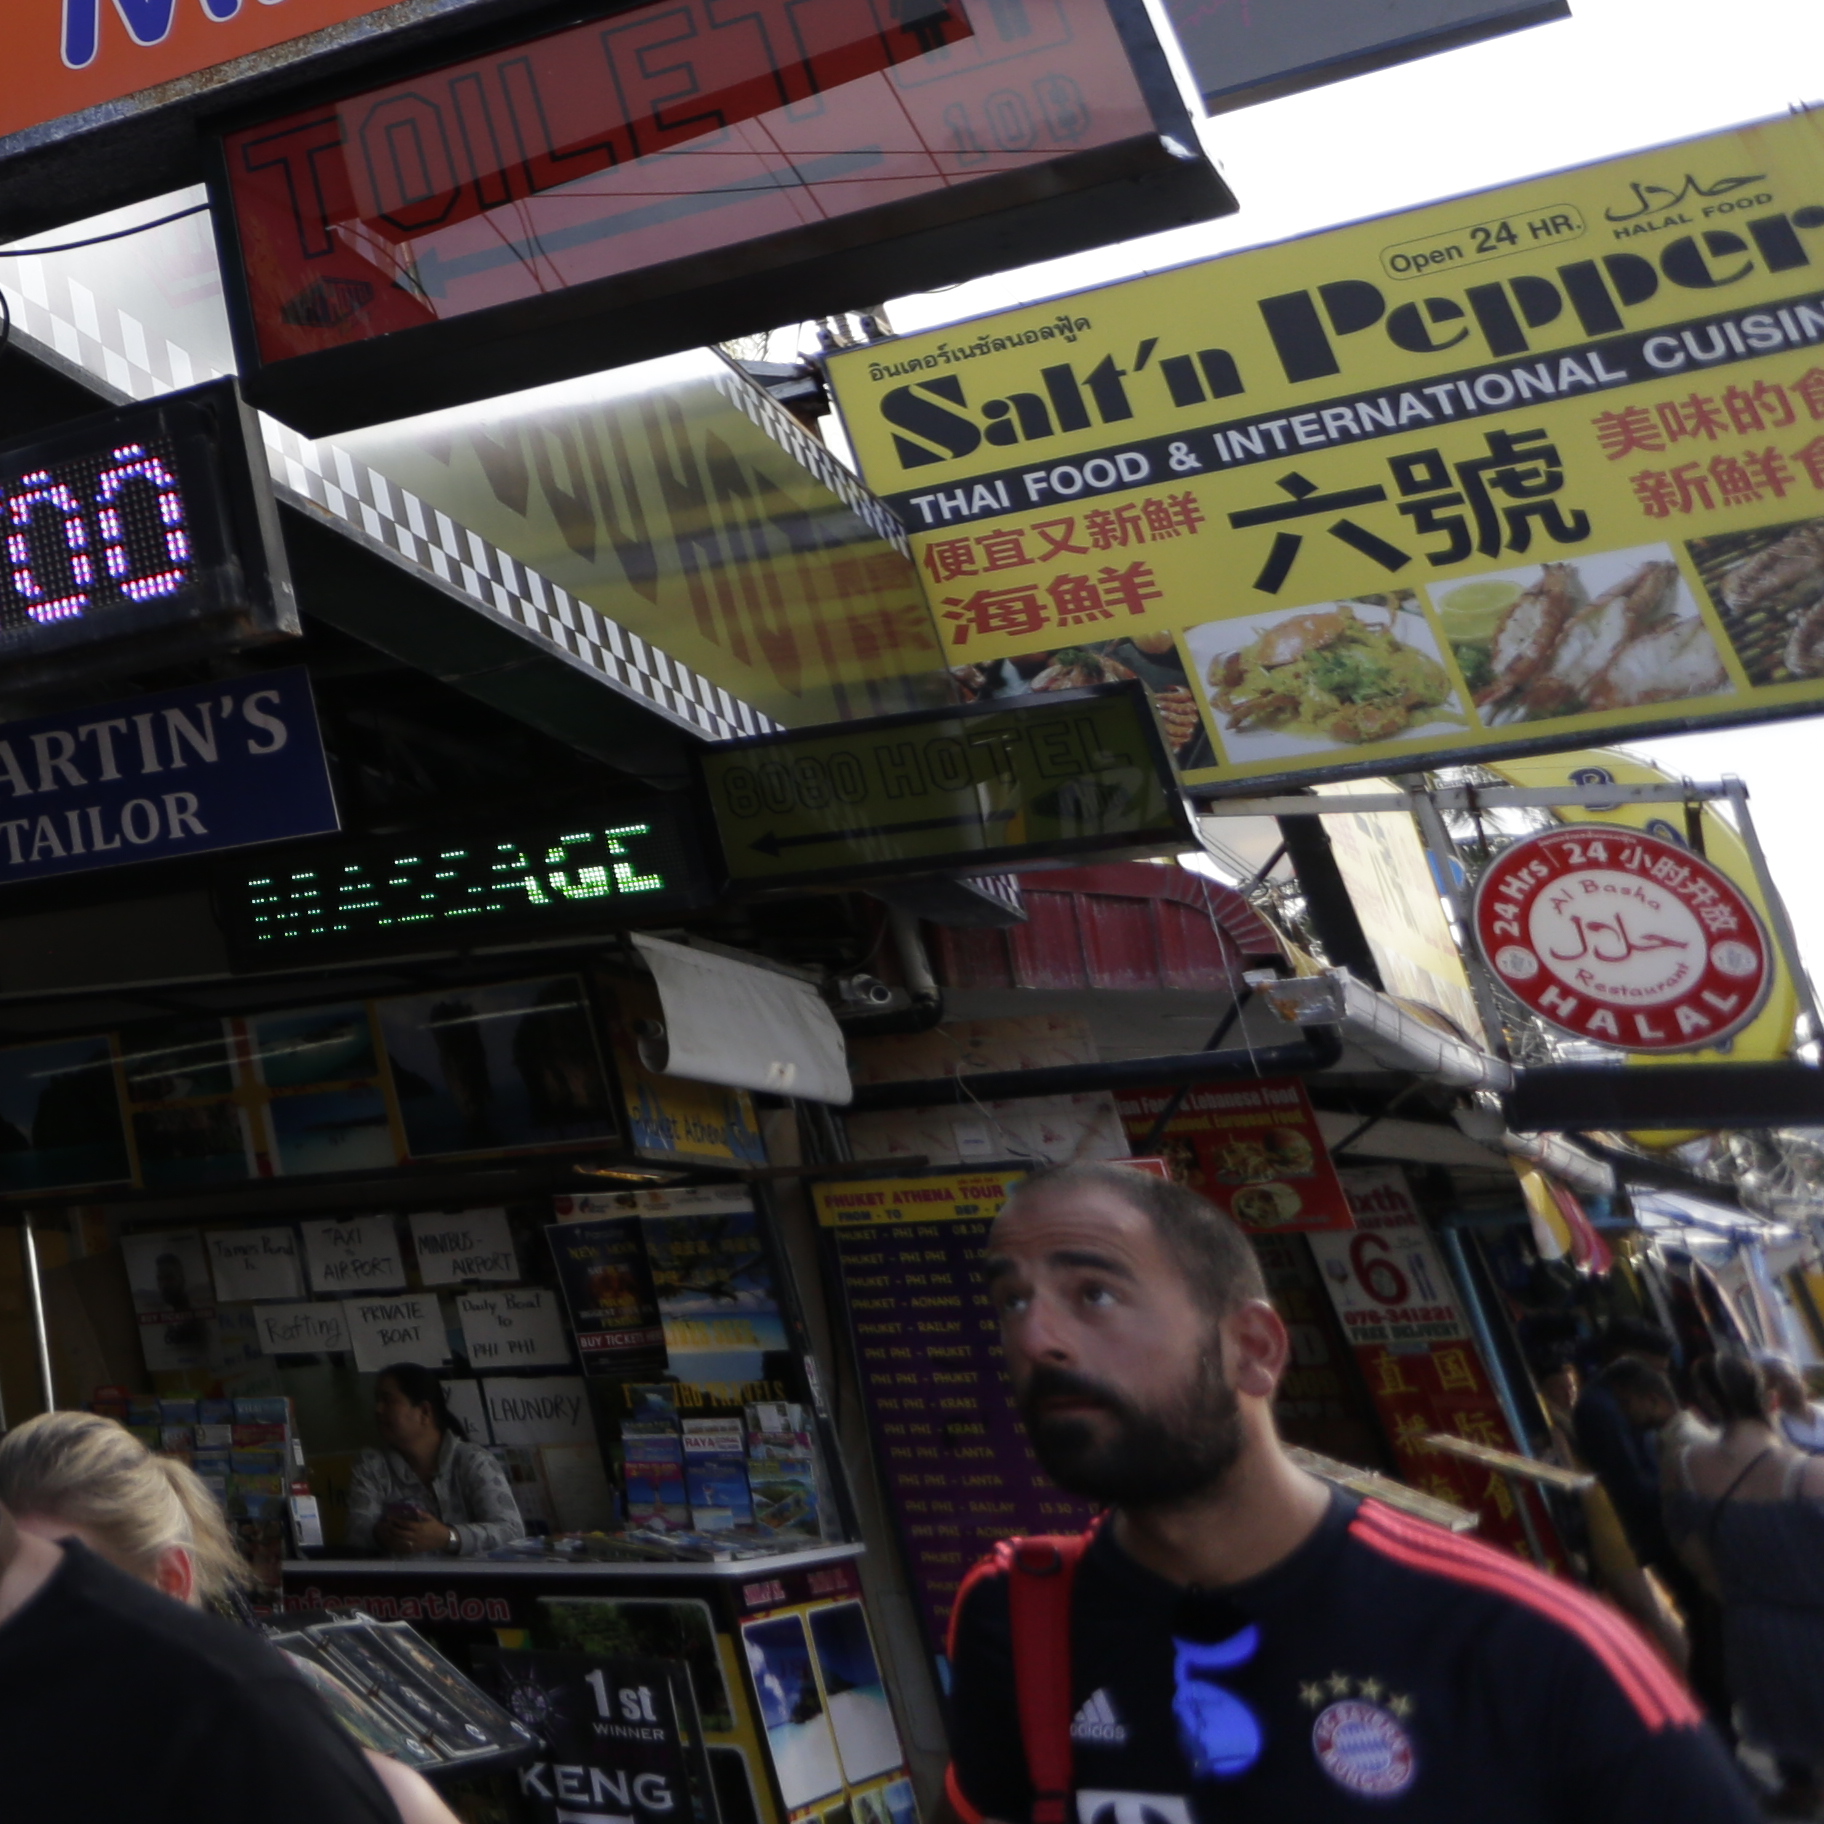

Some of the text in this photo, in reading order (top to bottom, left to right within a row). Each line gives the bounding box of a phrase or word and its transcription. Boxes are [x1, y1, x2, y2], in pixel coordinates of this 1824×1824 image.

[1613, 192, 1774, 240] HALAL FOOD
[1389, 213, 1583, 275] Open 24 HR.
[1258, 204, 1824, 384] Pepper
[909, 480, 1011, 524] THAI
[1025, 450, 1150, 502] FOOD
[1167, 441, 1202, 472] &
[1213, 351, 1628, 462] INTERNATIONAL
[1227, 428, 1591, 595] 六號
[940, 561, 1164, 645] 海鮮
[875, 716, 1134, 801] HOTEL
[1562, 841, 1609, 866] 24
[1492, 858, 1550, 938] 24 Hrs
[1538, 985, 1740, 1040] HALAL
[824, 1192, 885, 1208] PHUKET
[892, 1189, 955, 1204] ATHENA
[322, 1227, 362, 1247] TAXI
[324, 1257, 393, 1281] AIRPORT
[452, 1252, 512, 1276] AIRPORT
[1350, 1232, 1409, 1306] 6
[360, 1301, 425, 1323] PRIVATE
[504, 1293, 542, 1311] Boat
[265, 1314, 342, 1348] Rafting
[377, 1326, 422, 1347] BOAT
[579, 1333, 603, 1349] BUY
[472, 1338, 536, 1357] PHI PHI
[489, 1395, 582, 1426] LAUNDRY
[592, 1721, 666, 1743] WINNER
[517, 1762, 676, 1812] KENG
